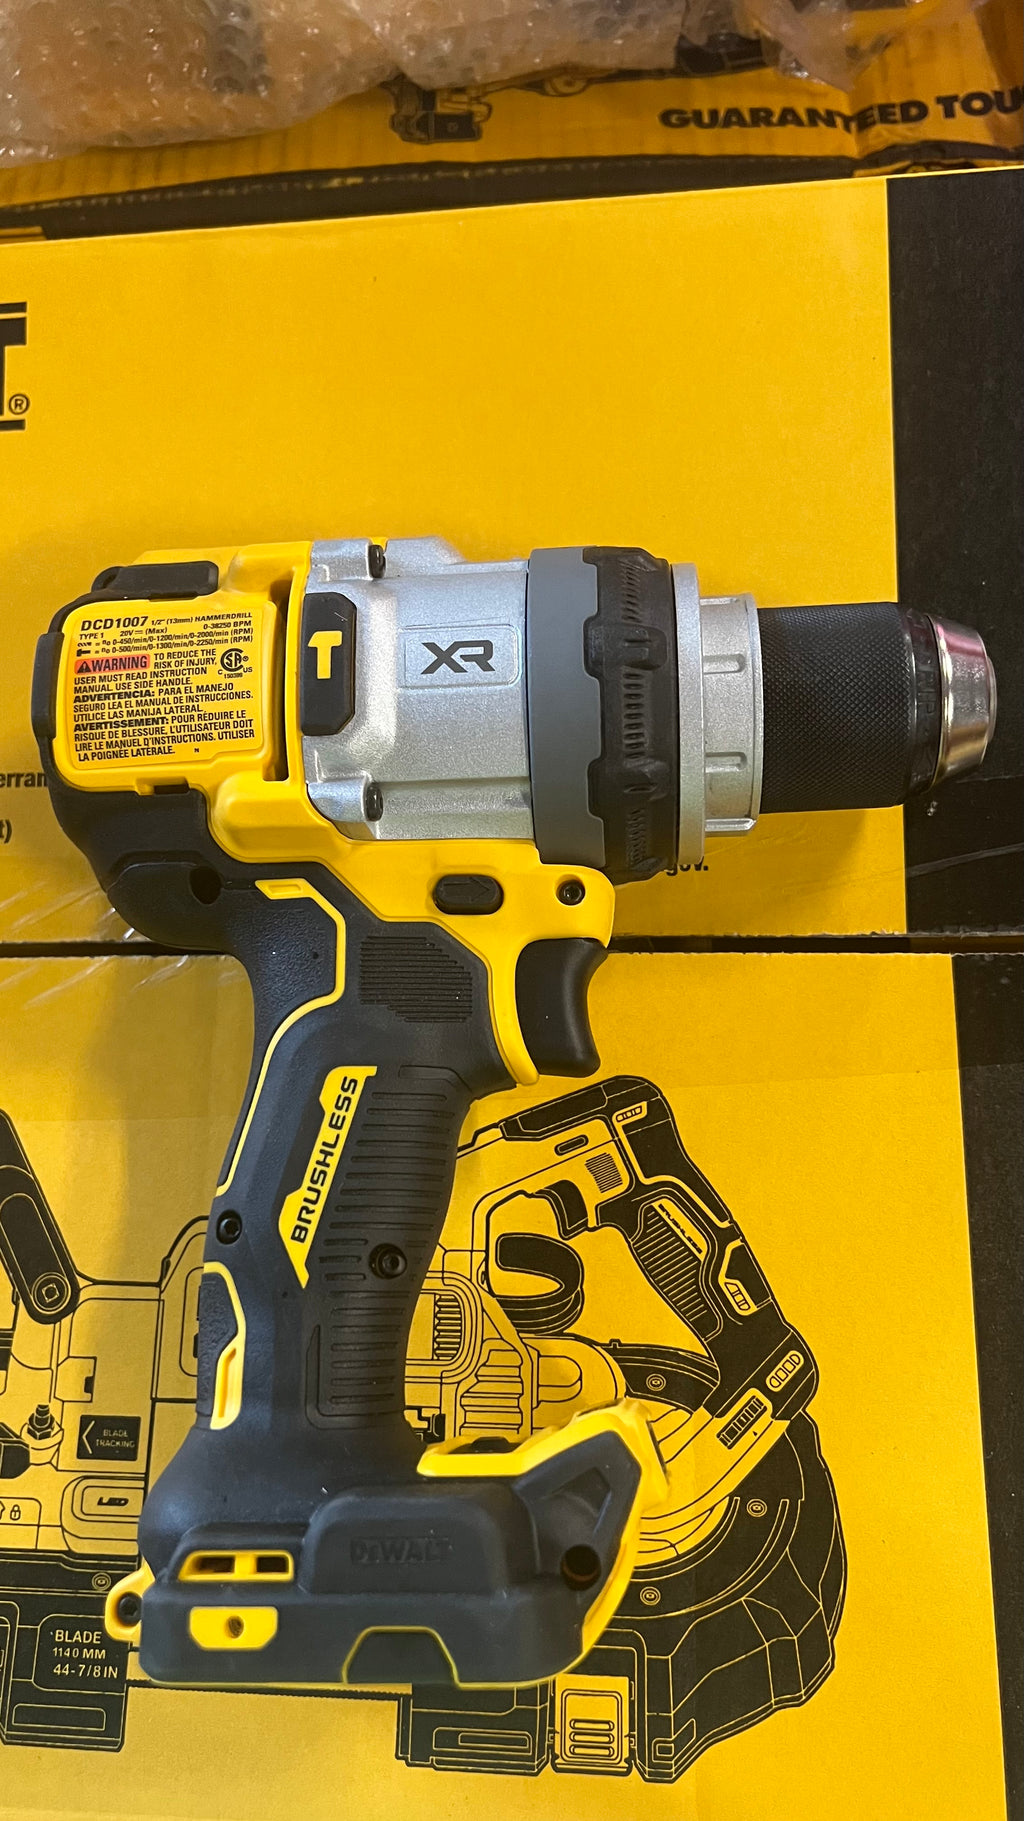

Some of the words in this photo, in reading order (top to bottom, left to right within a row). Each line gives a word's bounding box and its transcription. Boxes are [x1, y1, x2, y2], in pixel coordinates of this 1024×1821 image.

[659, 100, 929, 134] GUARANTEED
[81, 616, 148, 631] DCD1007
[195, 612, 252, 622] HAMMERDRILL
[146, 627, 167, 635] (Max)
[231, 628, 253, 636] (RPM)
[231, 636, 253, 644] (RPM)
[167, 650, 198, 659] REDUCE
[421, 640, 495, 674] XR
[92, 656, 147, 671] WARNING
[154, 661, 172, 669] RISK
[186, 657, 217, 666] INJURY,
[74, 676, 96, 685] USER
[99, 674, 123, 683] MUST
[126, 672, 147, 680] READ
[150, 667, 207, 678] INSTRUCTION
[116, 682, 132, 691] USE
[134, 680, 153, 689] SIDE
[156, 677, 192, 688] HANDLE.
[74, 690, 155, 703] ADVERTENCIA:
[158, 687, 182, 696] PARA
[184, 686, 193, 694] EL
[196, 683, 233, 693] MANEJO
[74, 703, 105, 713] SEGURO
[108, 701, 122, 710] LEA
[125, 700, 133, 708] EL
[136, 698, 171, 707] MANUAL
[173, 696, 184, 704] DE
[186, 690, 253, 703] INSTRUCCIONES.
[74, 712, 106, 722] UTILICE
[108, 711, 124, 719] LAS
[126, 707, 162, 718] MANIJA
[74, 717, 168, 732] AVERTISSEMENT:
[171, 714, 195, 724] POUR
[236, 710, 246, 718] LE
[74, 732, 106, 742] RISQUE
[108, 730, 119, 739] DE
[170, 721, 230, 734] L'UTILISATEUR
[233, 719, 253, 729] DOIT
[75, 742, 92, 752] LIRE
[94, 742, 104, 750] LE
[106, 739, 142, 749] MANUEL
[144, 732, 216, 746] D'INSTRUCTIONS.
[218, 729, 255, 740] UTILISER
[78, 753, 89, 762] LA
[291, 1076, 358, 1243] BRUSHLESS
[103, 1429, 128, 1437] BLADE
[96, 1439, 135, 1448] TRACKING
[55, 1630, 102, 1644] BLADE
[53, 1647, 79, 1658] 1140
[83, 1648, 106, 1659] MM
[104, 1665, 118, 1678] IN
